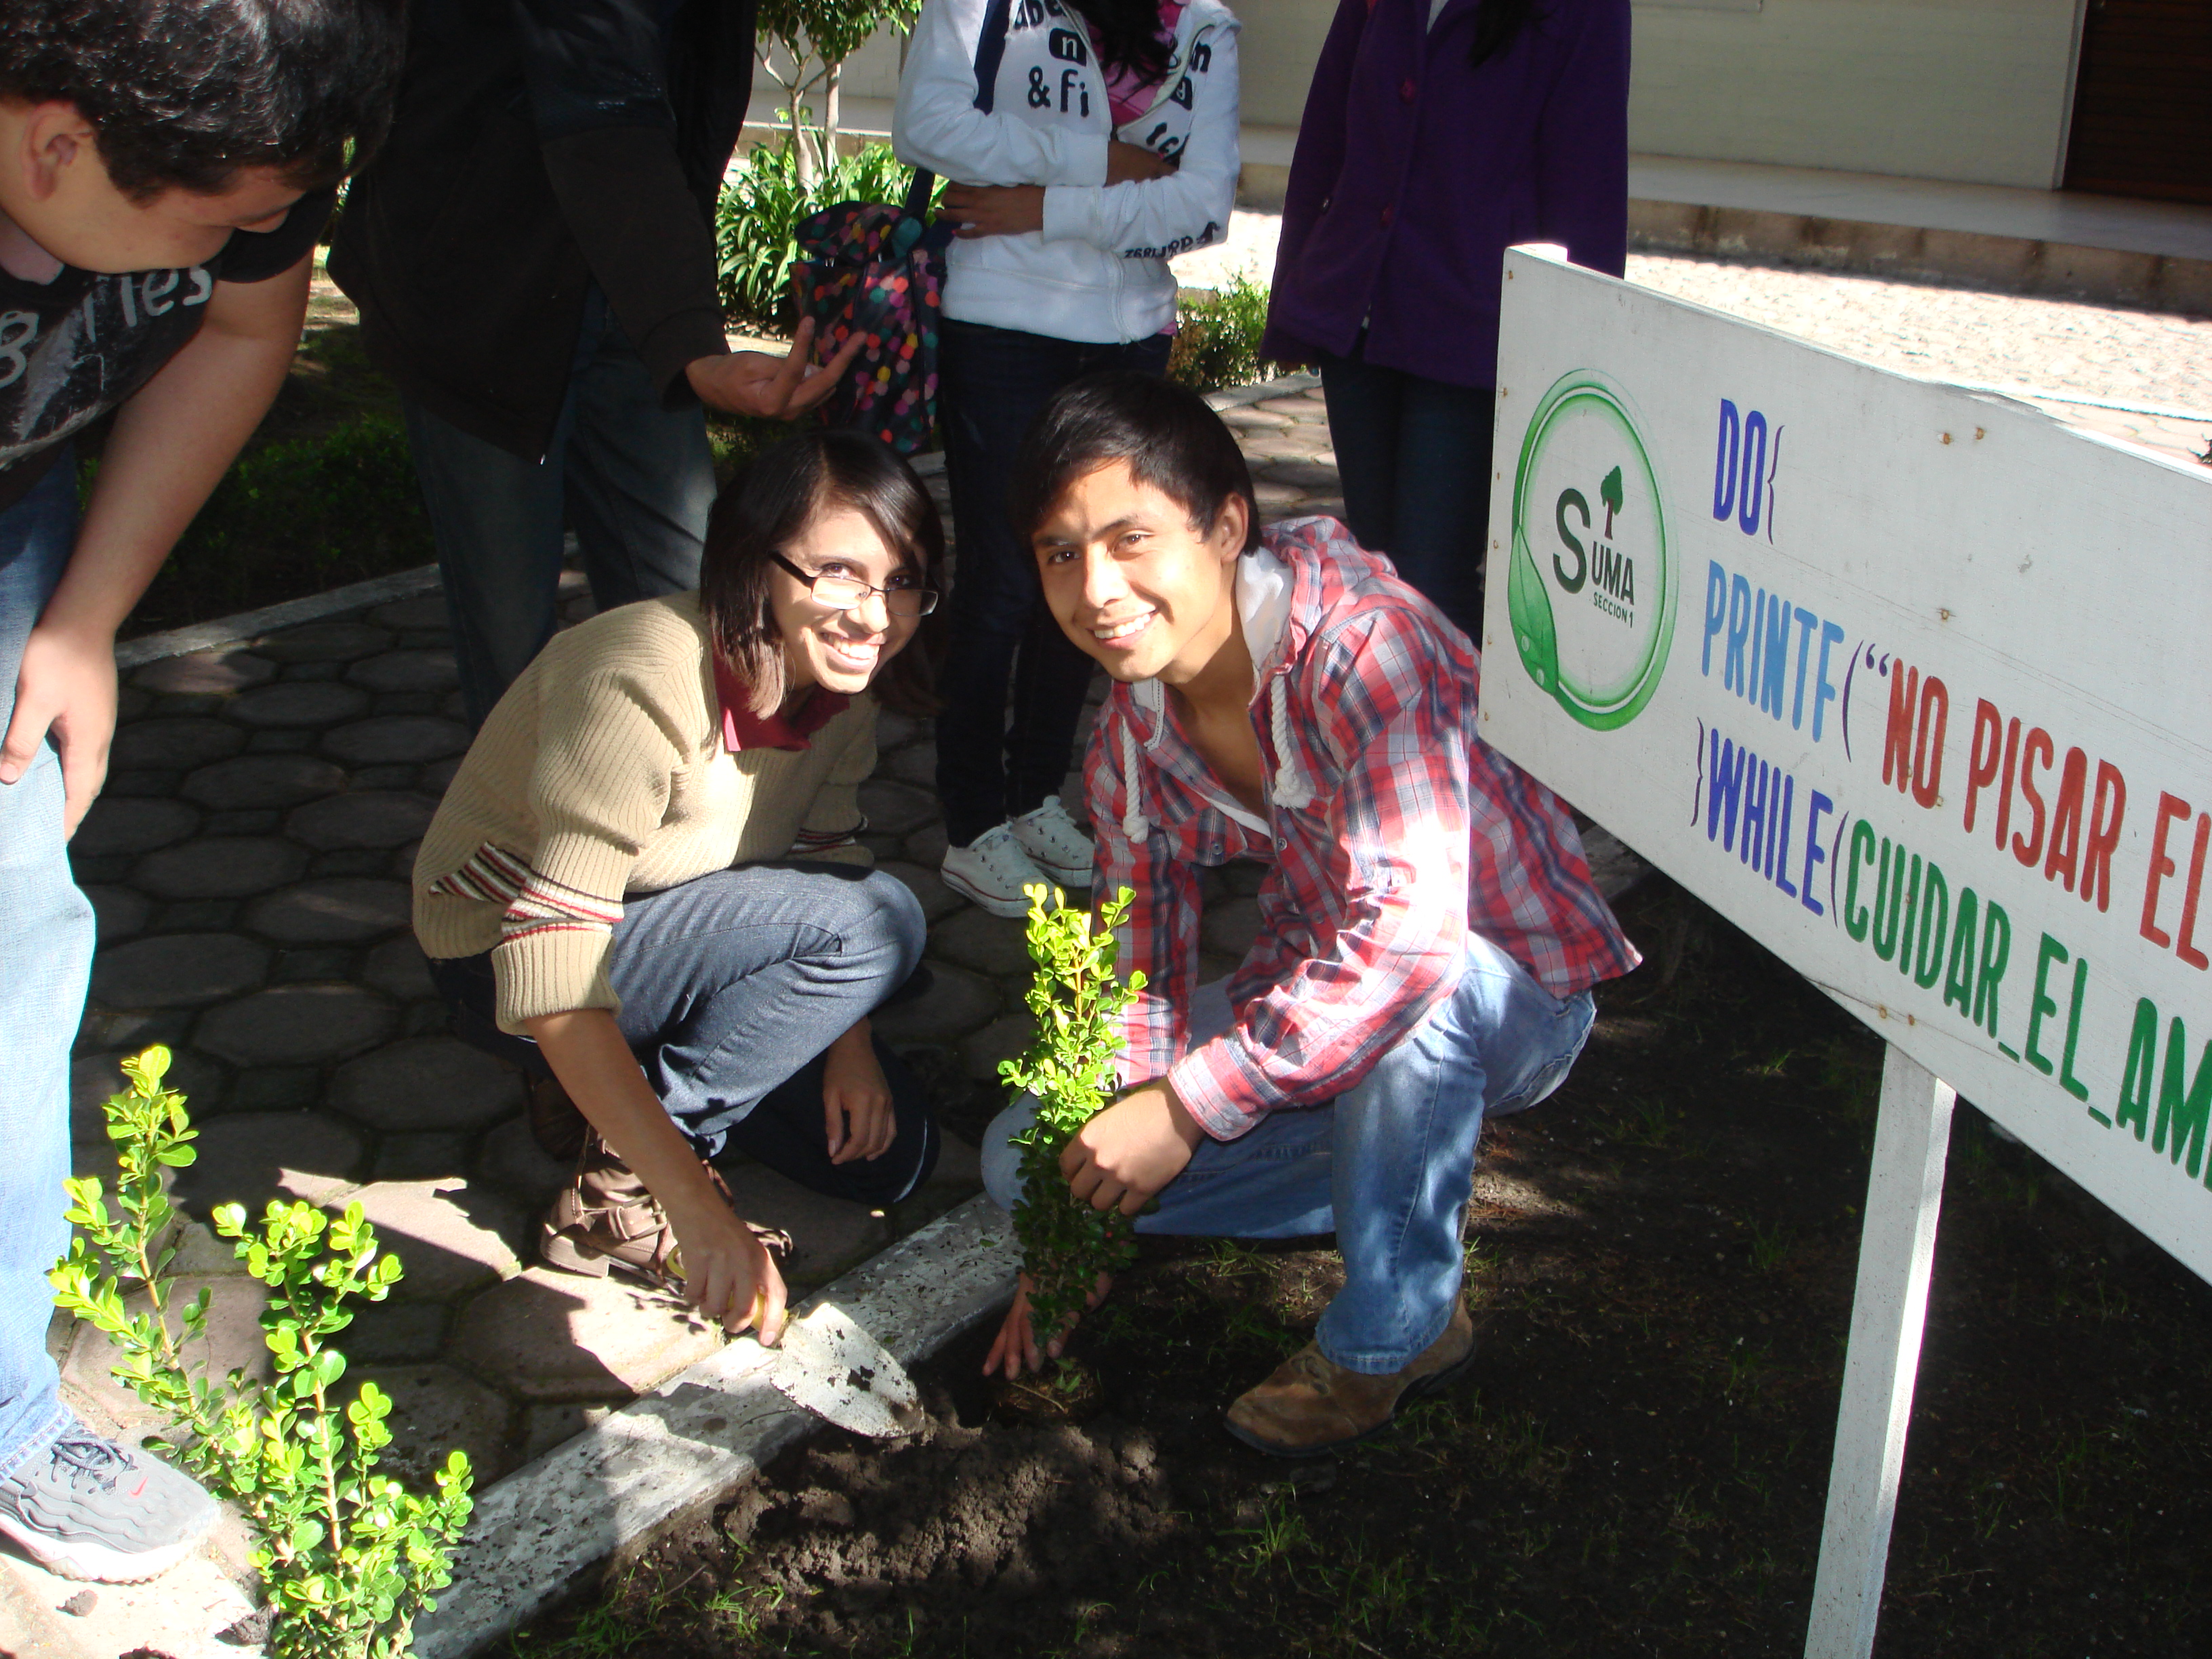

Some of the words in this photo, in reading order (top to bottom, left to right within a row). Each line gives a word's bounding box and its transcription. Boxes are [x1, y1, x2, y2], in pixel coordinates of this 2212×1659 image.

[1027, 65, 1051, 109] &
[1552, 487, 1635, 606] SUMA
[1593, 592, 1628, 623] SECCION
[1963, 697, 2127, 913] PISAR
[2139, 791, 2211, 971] EL
